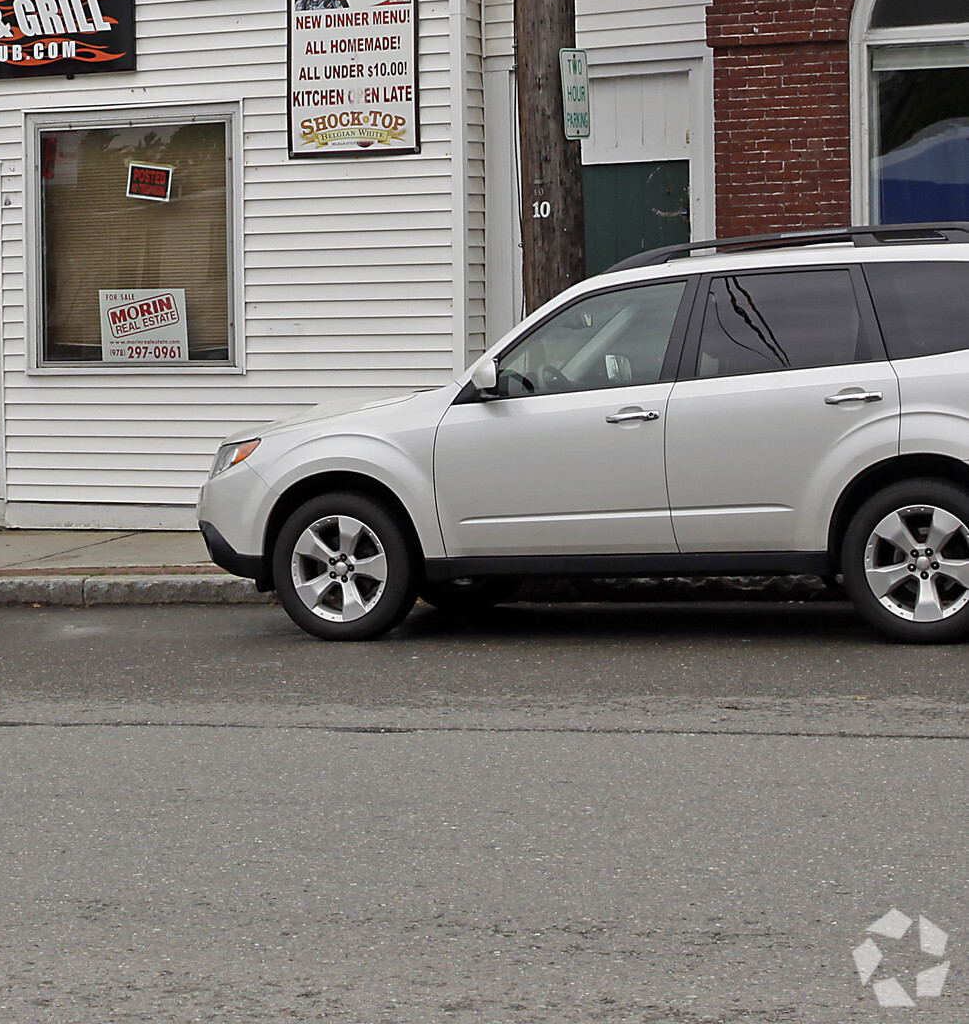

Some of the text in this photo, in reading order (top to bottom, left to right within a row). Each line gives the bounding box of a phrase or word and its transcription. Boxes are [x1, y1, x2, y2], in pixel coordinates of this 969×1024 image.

[295, 9, 411, 30] NEW DINNER MENU!
[305, 36, 401, 55] ALL HOMEMADE!
[299, 61, 408, 81] ALL UNDER $10.00!
[567, 59, 583, 76] TWO
[293, 89, 344, 107] KITCHEN
[383, 85, 413, 103] LATE
[567, 86, 586, 102] HOUR
[566, 112, 589, 129] PARKING
[321, 129, 356, 141] BELGIAN
[133, 168, 168, 185] POSTED
[532, 201, 551, 219] 10
[110, 296, 172, 325] MORIN
[115, 310, 177, 335] REAL ESTATE
[110, 346, 181, 359] (978) 297-0961
